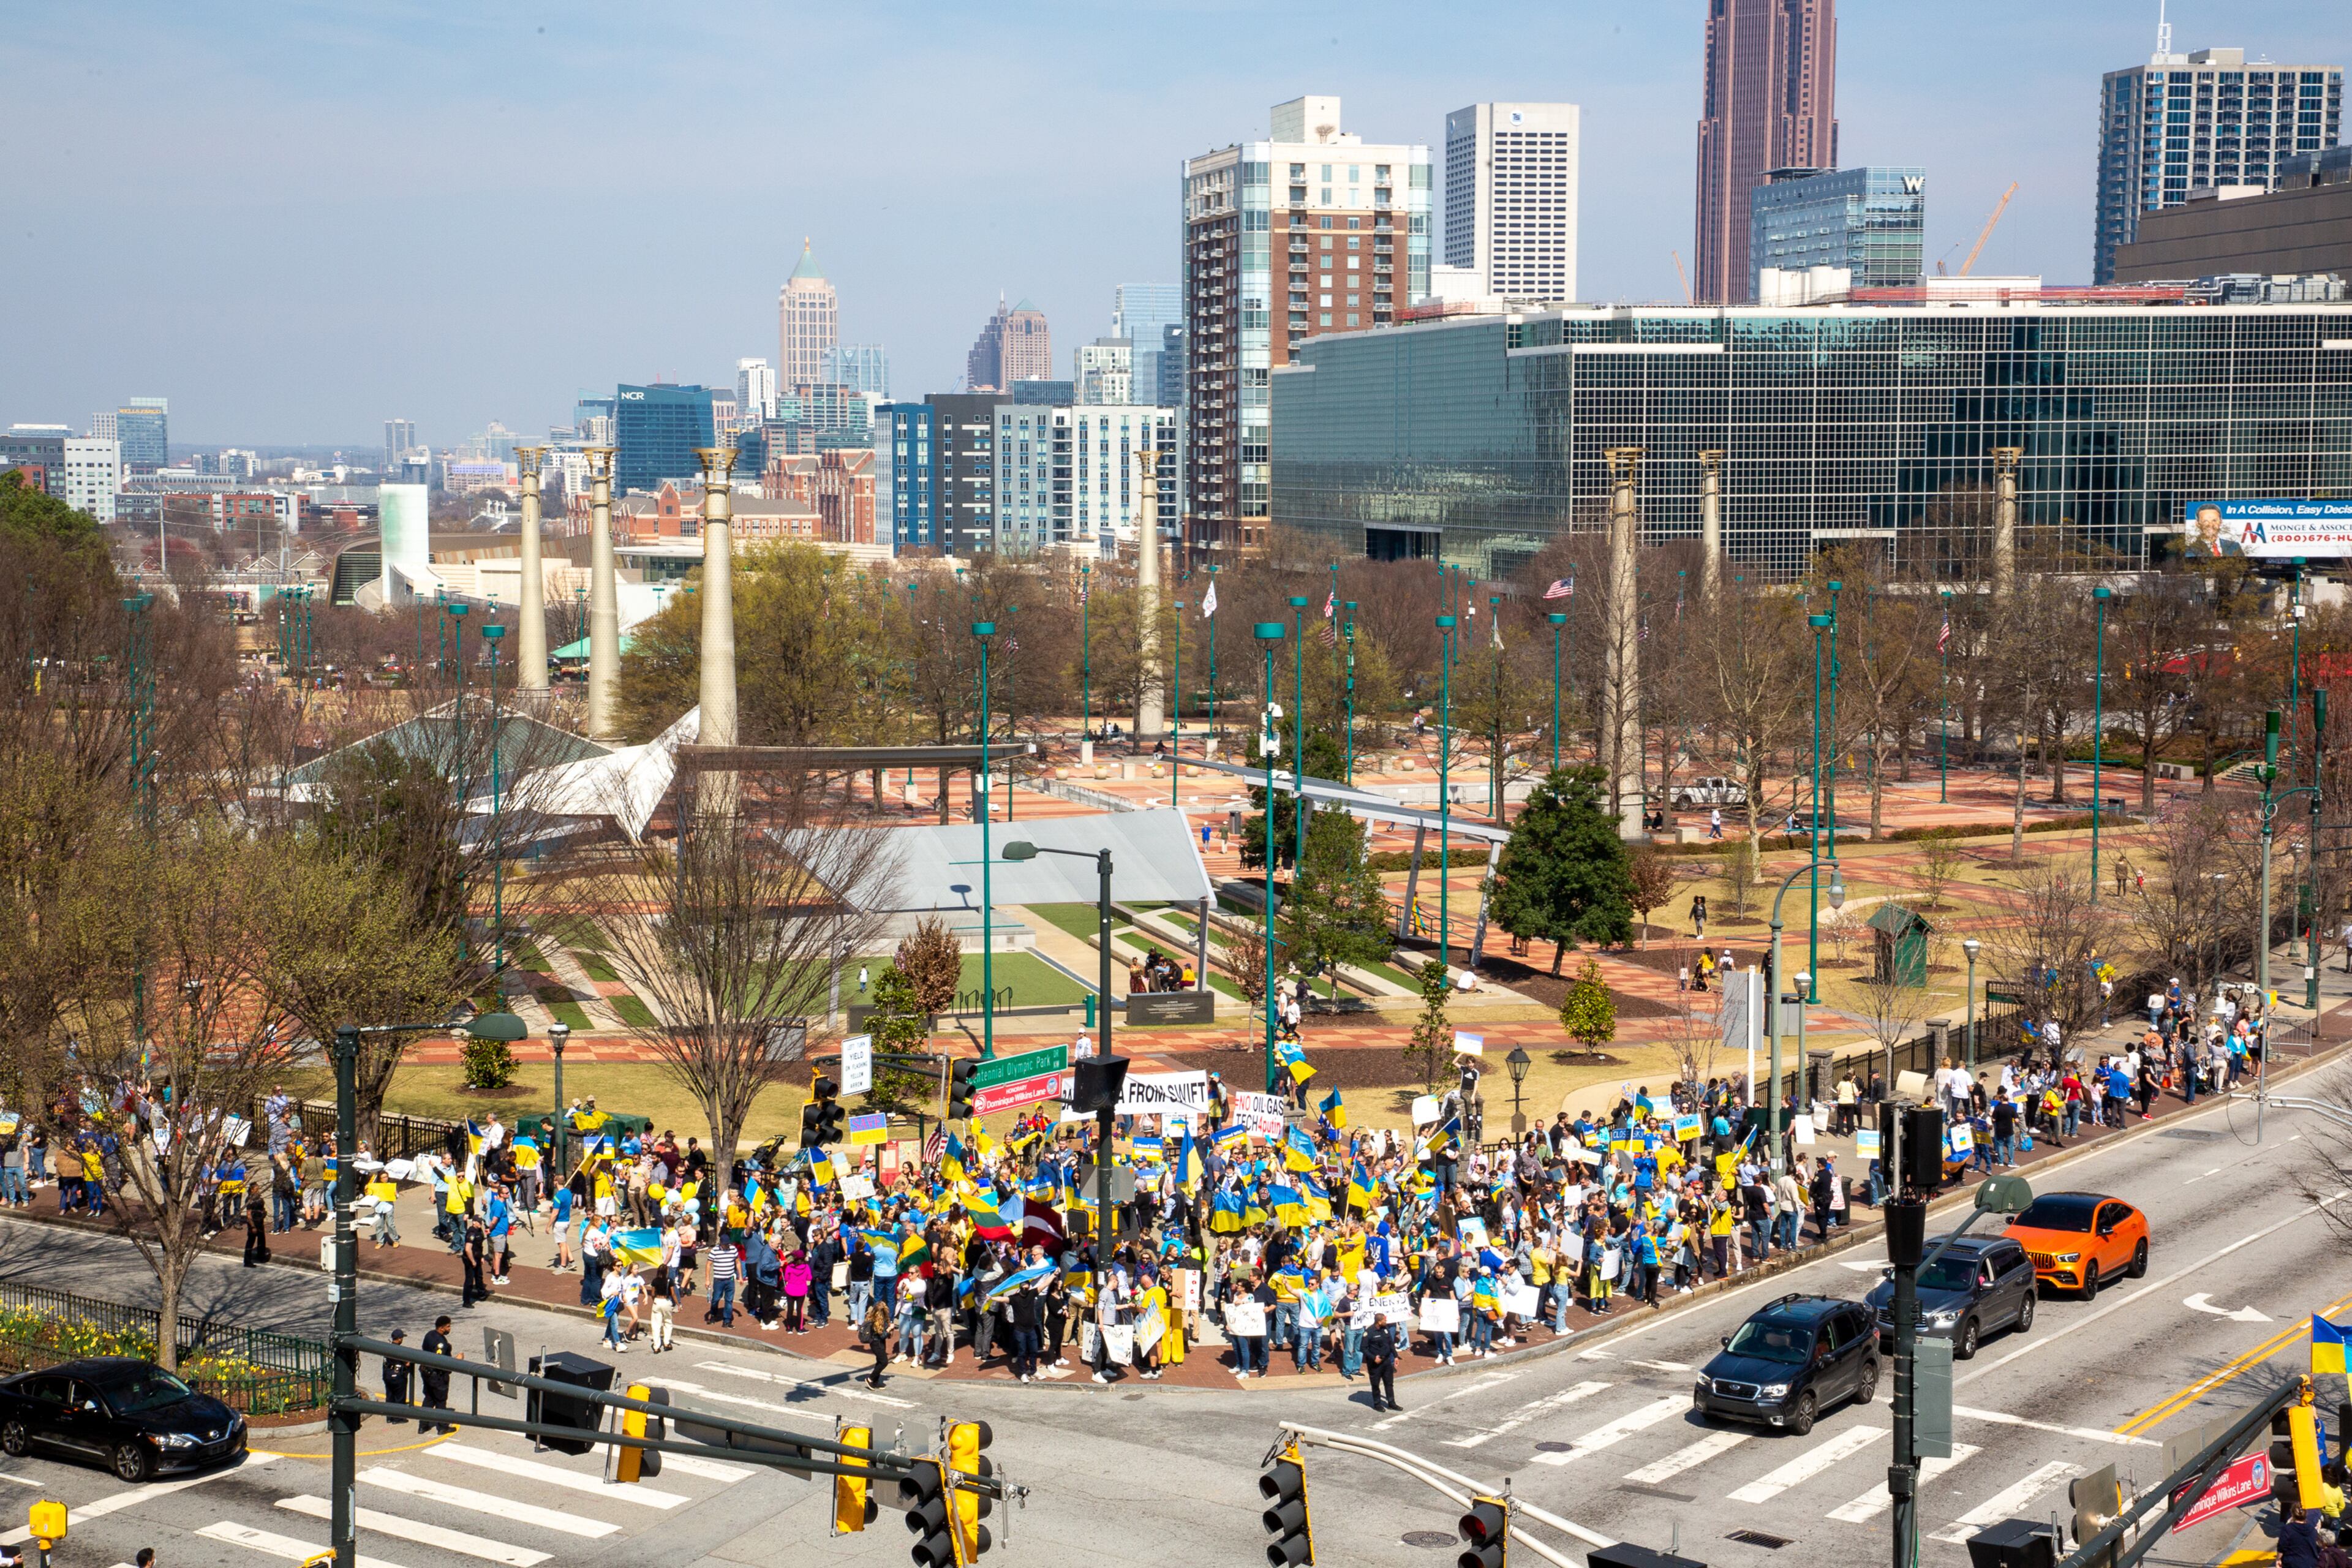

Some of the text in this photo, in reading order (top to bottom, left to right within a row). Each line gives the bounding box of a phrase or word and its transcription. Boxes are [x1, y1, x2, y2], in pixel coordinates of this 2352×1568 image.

[1903, 176, 1925, 193] W
[621, 391, 644, 400] NCR
[2226, 505, 2236, 514] In
[2237, 505, 2246, 514] A
[2247, 505, 2294, 515] Collision,
[2296, 505, 2323, 516] Easy
[850, 1051, 864, 1060] YIELD
[969, 1054, 1051, 1084] entennial Olympic Park
[1006, 1084, 1028, 1095] HONORARY
[1129, 1082, 1165, 1103] FROM
[1167, 1082, 1205, 1103] SWIFT
[986, 1088, 1046, 1109] Dominique Wilkins Lane
[851, 1115, 882, 1131] SAVE
[1679, 1126, 1700, 1136] UKRAINE
[2216, 1485, 2236, 1503] Wilkins
[2236, 1479, 2252, 1494] Lane
